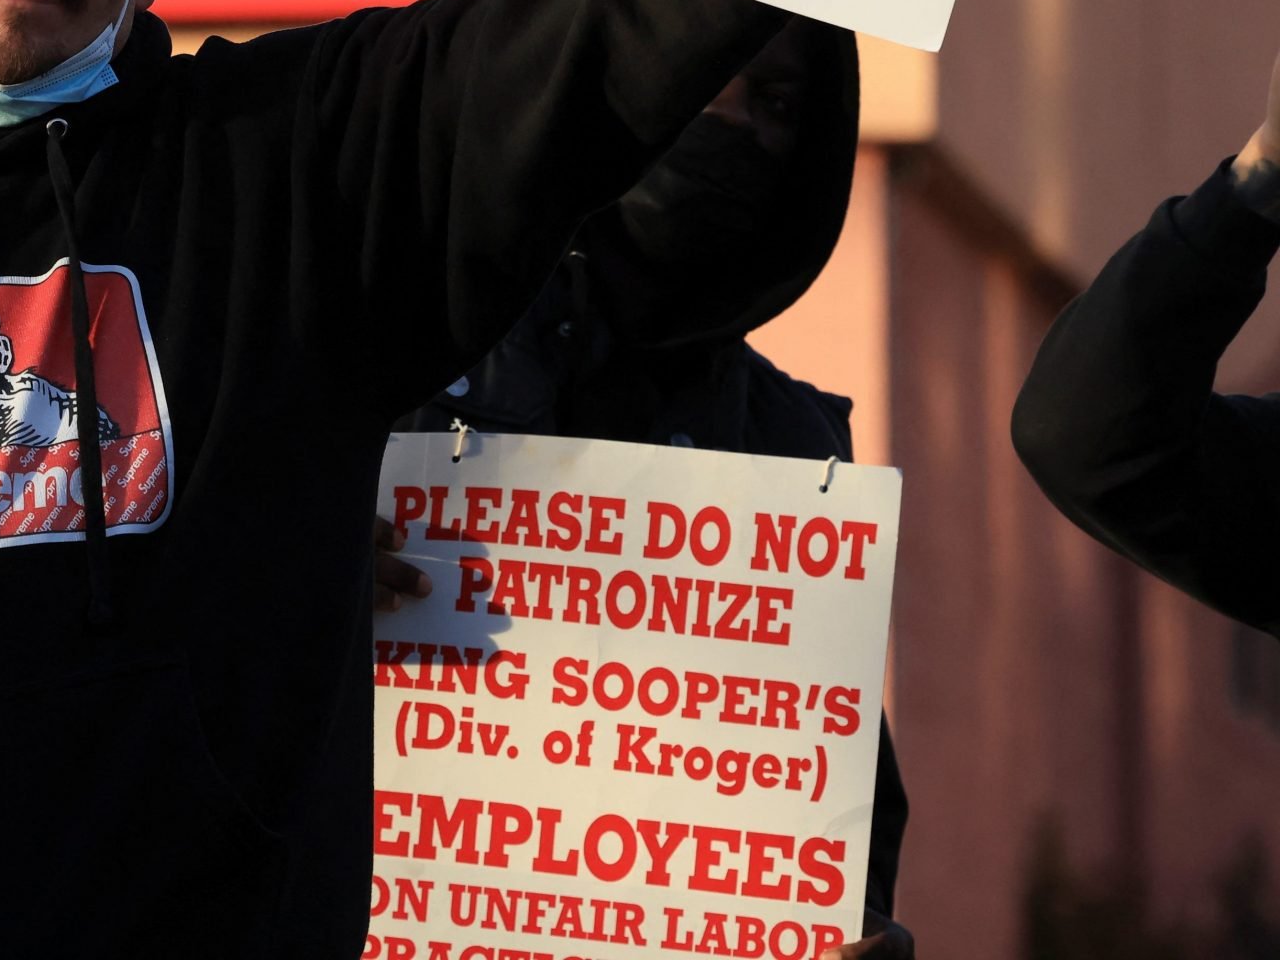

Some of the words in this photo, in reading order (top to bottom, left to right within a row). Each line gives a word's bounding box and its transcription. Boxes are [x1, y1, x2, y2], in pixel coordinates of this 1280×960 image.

[117, 447, 150, 489] Supreme
[393, 486, 627, 556] PLEASE
[643, 501, 732, 567] DO
[750, 512, 878, 581] NOT
[455, 556, 794, 646] PATRONIZE
[373, 642, 530, 700] KING
[552, 656, 862, 737] SOOPER'S
[394, 701, 519, 759] (Div.
[542, 720, 596, 767] of
[613, 723, 828, 802] Kroger)
[373, 790, 847, 907] EMPLOYEES
[448, 883, 647, 947] UNFAIR
